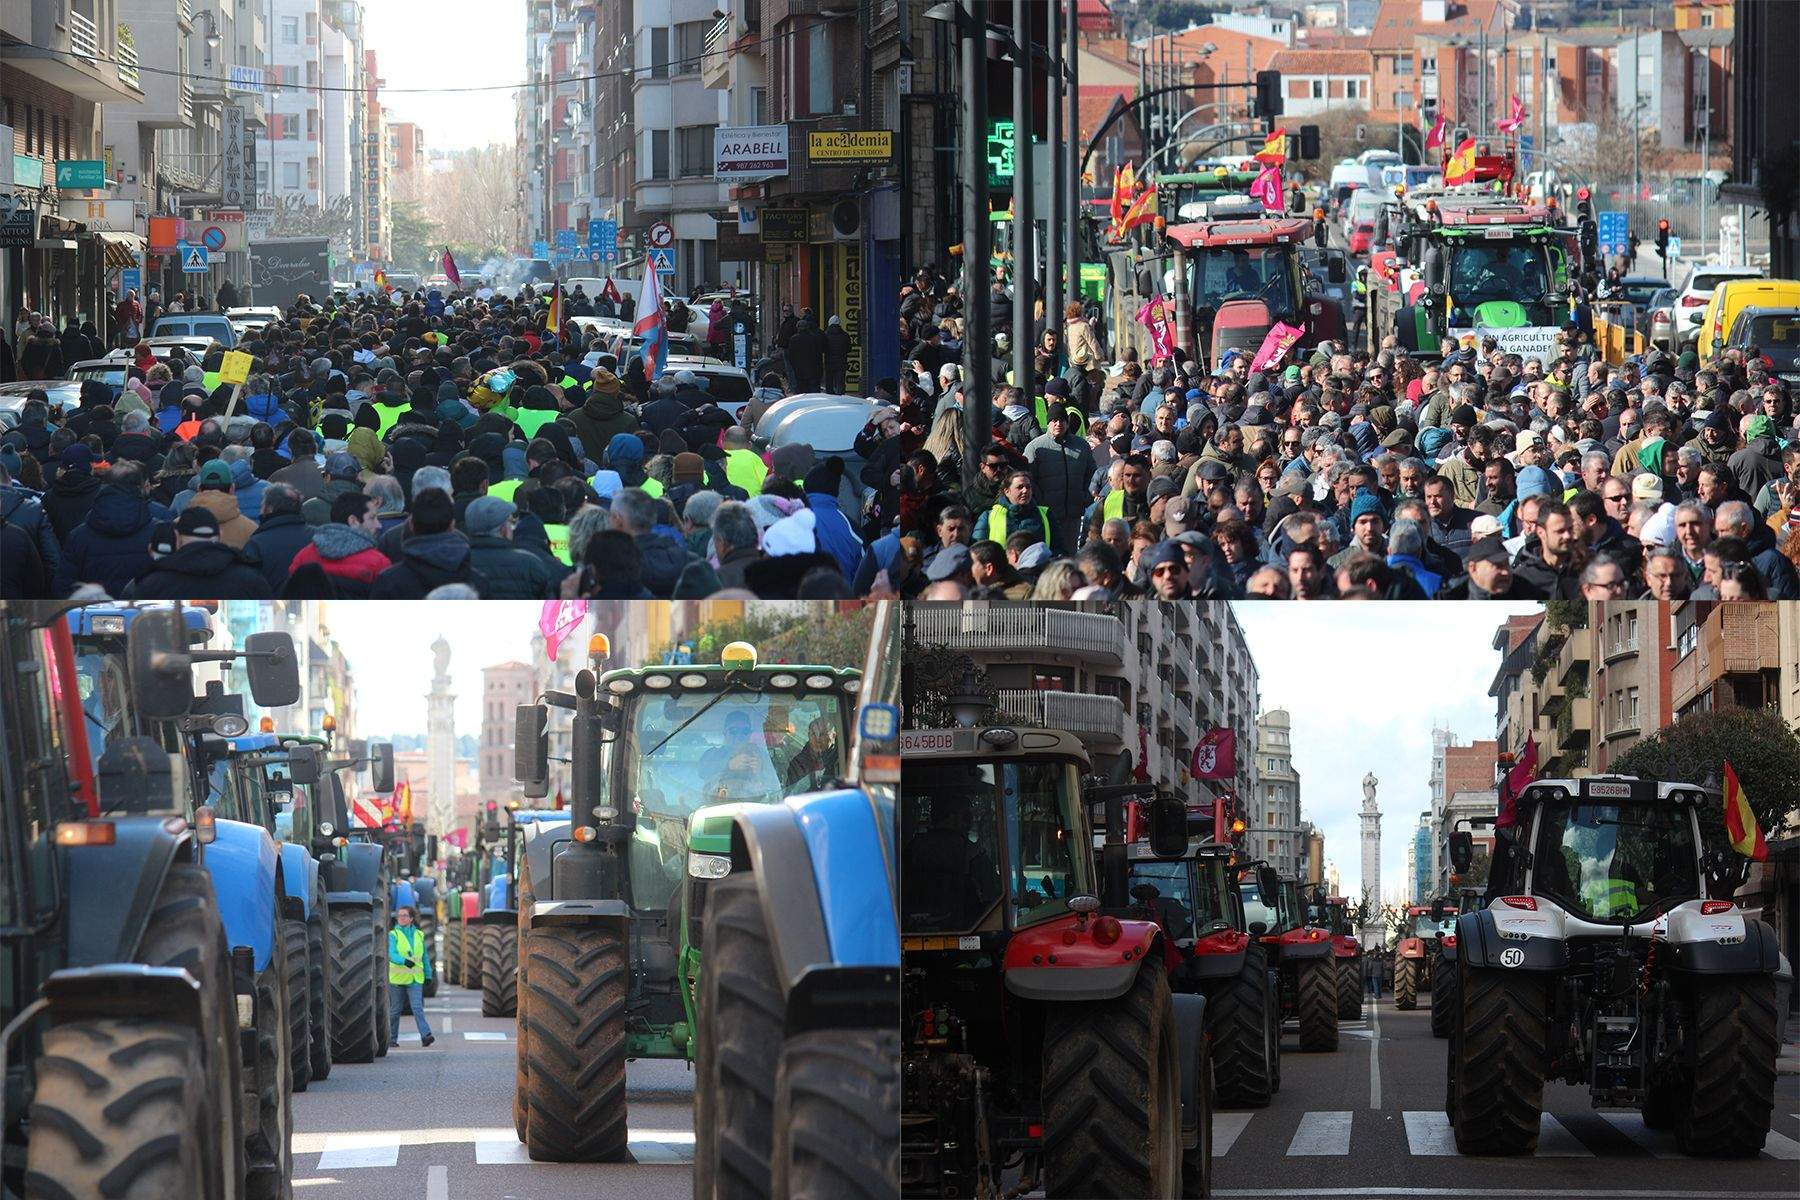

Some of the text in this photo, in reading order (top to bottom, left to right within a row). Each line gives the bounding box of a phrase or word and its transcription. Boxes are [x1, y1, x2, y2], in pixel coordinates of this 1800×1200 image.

[230, 67, 263, 92] HOSTAL
[811, 134, 822, 147] la
[721, 142, 783, 155] ARABELL
[226, 107, 241, 204] RIALTO
[1, 227, 30, 236] ATTOO
[1502, 334, 1554, 342] AGRICULTU
[1505, 950, 1521, 965] 50
